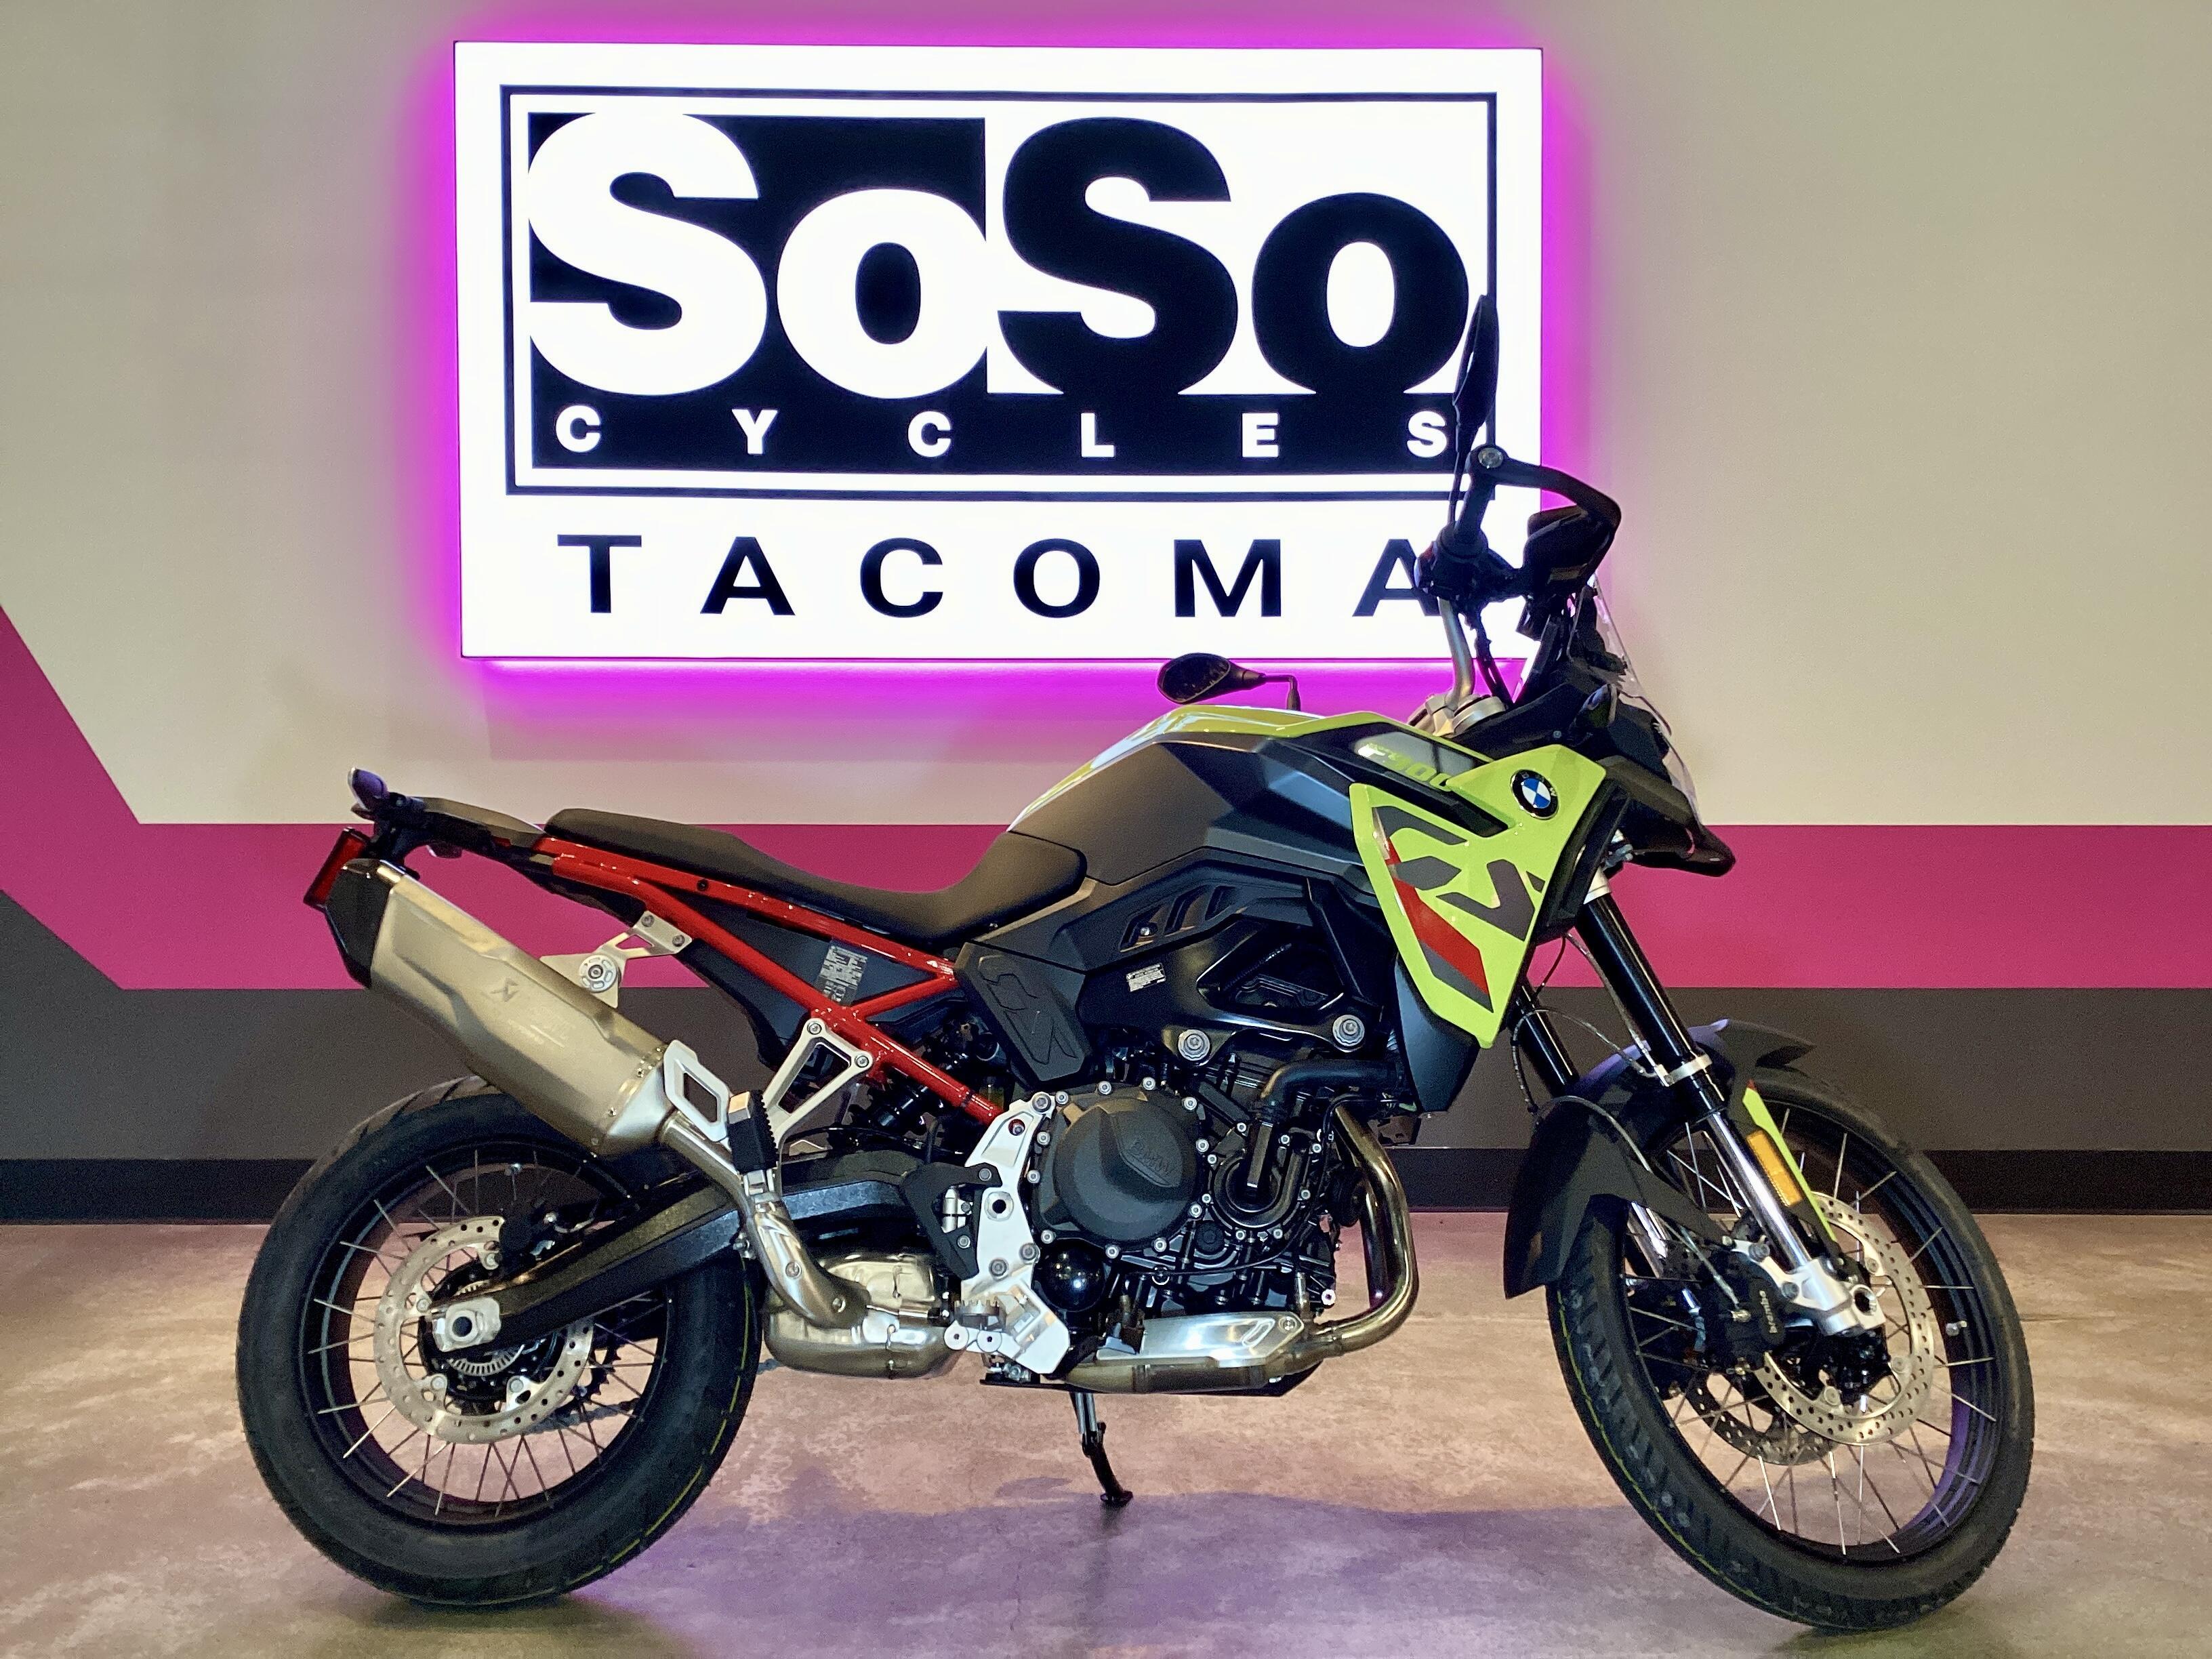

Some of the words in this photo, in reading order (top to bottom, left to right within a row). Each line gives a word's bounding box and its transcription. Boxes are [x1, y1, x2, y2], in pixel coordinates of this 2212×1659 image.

[527, 112, 1469, 398] SoSo
[555, 405, 1448, 458] CYCLES
[557, 534, 1441, 618] TACOMA
